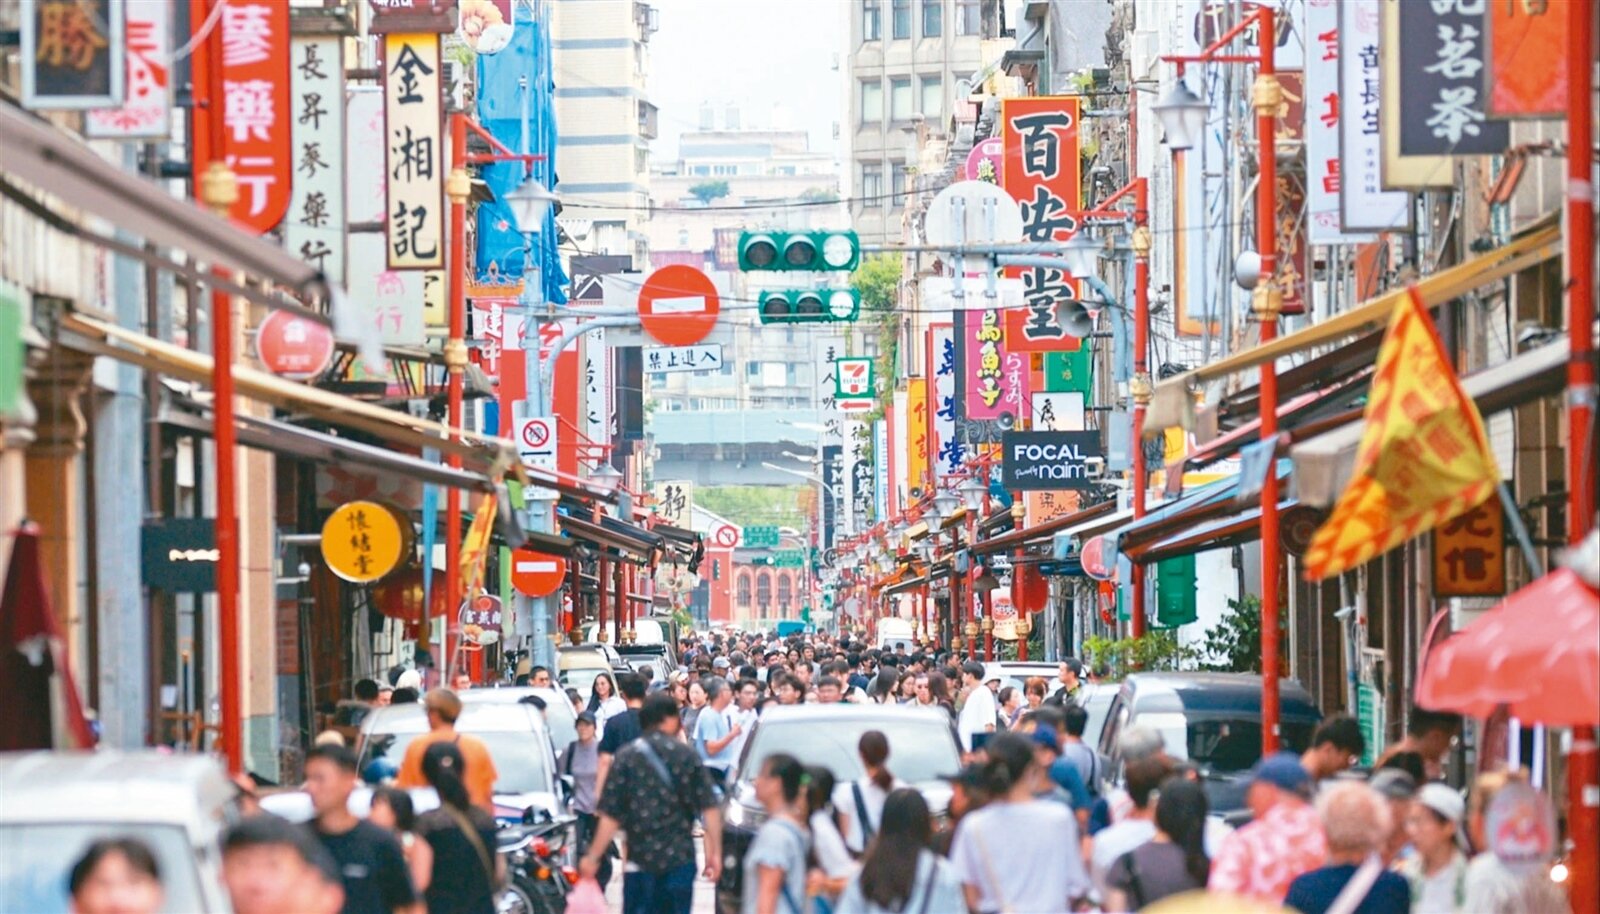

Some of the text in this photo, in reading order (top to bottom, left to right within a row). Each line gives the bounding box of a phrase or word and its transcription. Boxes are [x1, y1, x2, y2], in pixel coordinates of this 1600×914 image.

[389, 42, 438, 261] 金湘記
[1013, 112, 1076, 339] 百安堂
[1013, 444, 1087, 461] FOCAL
[1039, 460, 1088, 479] naim
